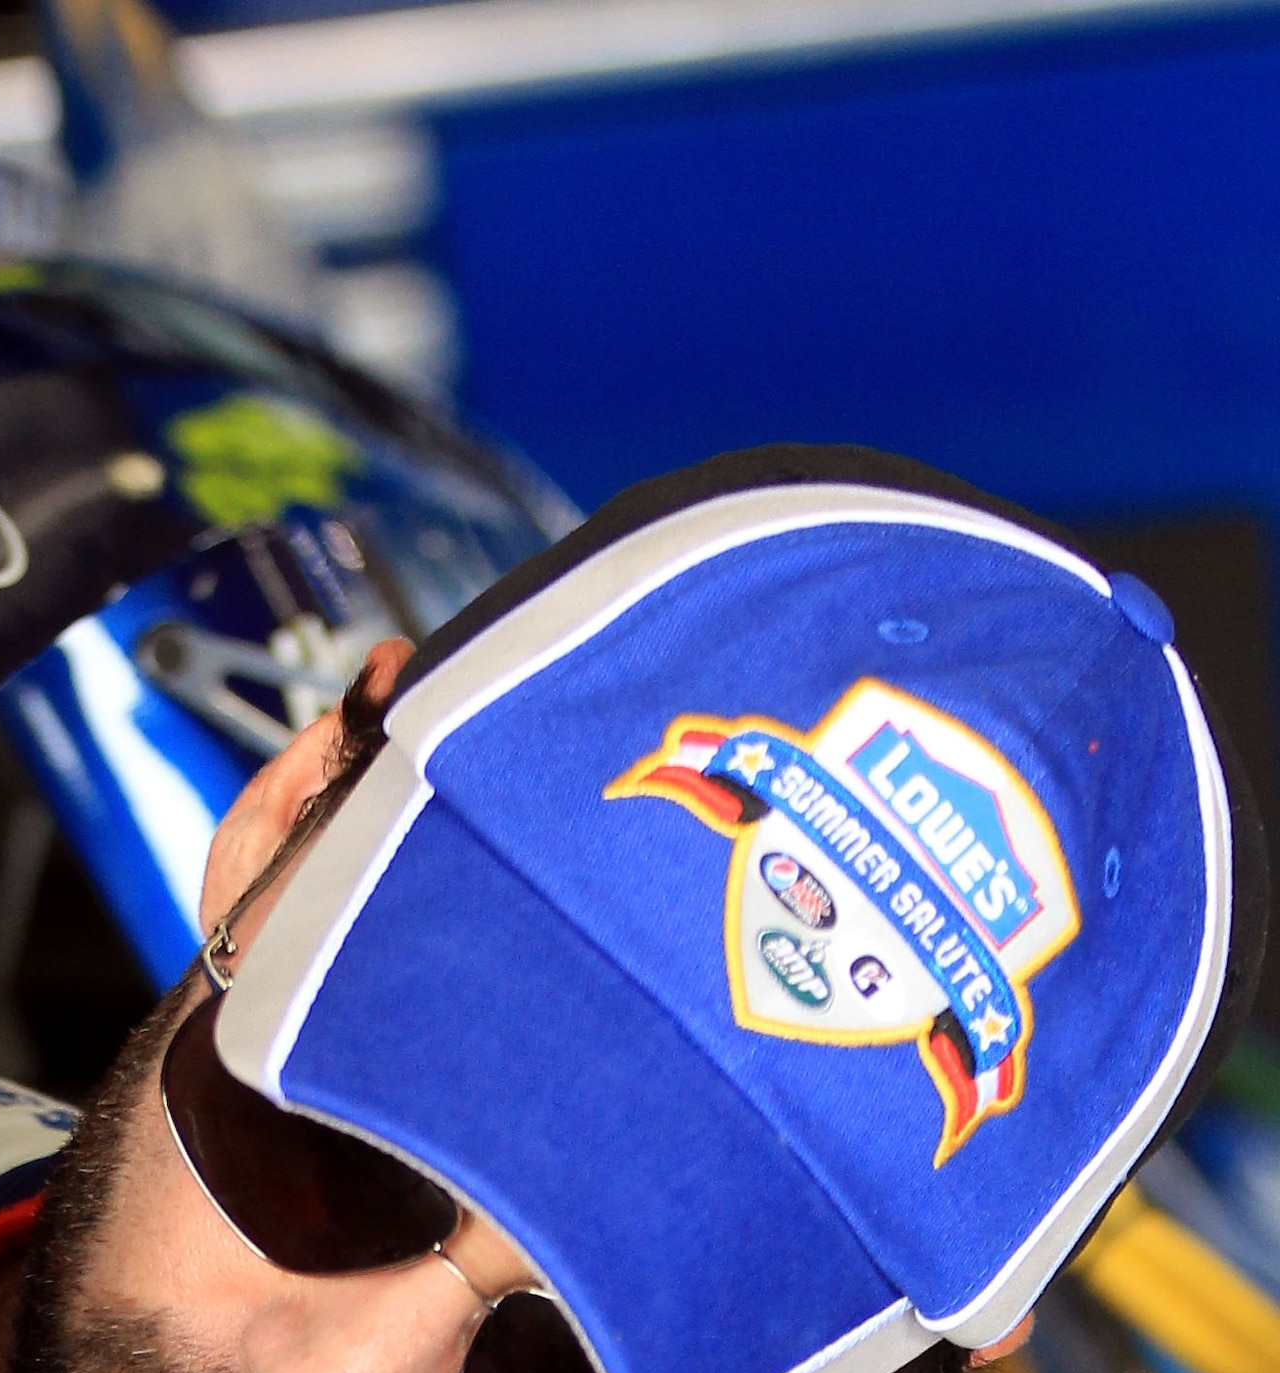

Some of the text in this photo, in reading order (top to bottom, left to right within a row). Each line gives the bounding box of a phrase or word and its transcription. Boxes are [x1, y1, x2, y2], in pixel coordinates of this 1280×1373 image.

[771, 766, 901, 894] SUMMER
[892, 884, 993, 1013] SALUTE
[867, 739, 1018, 922] LOWE'S
